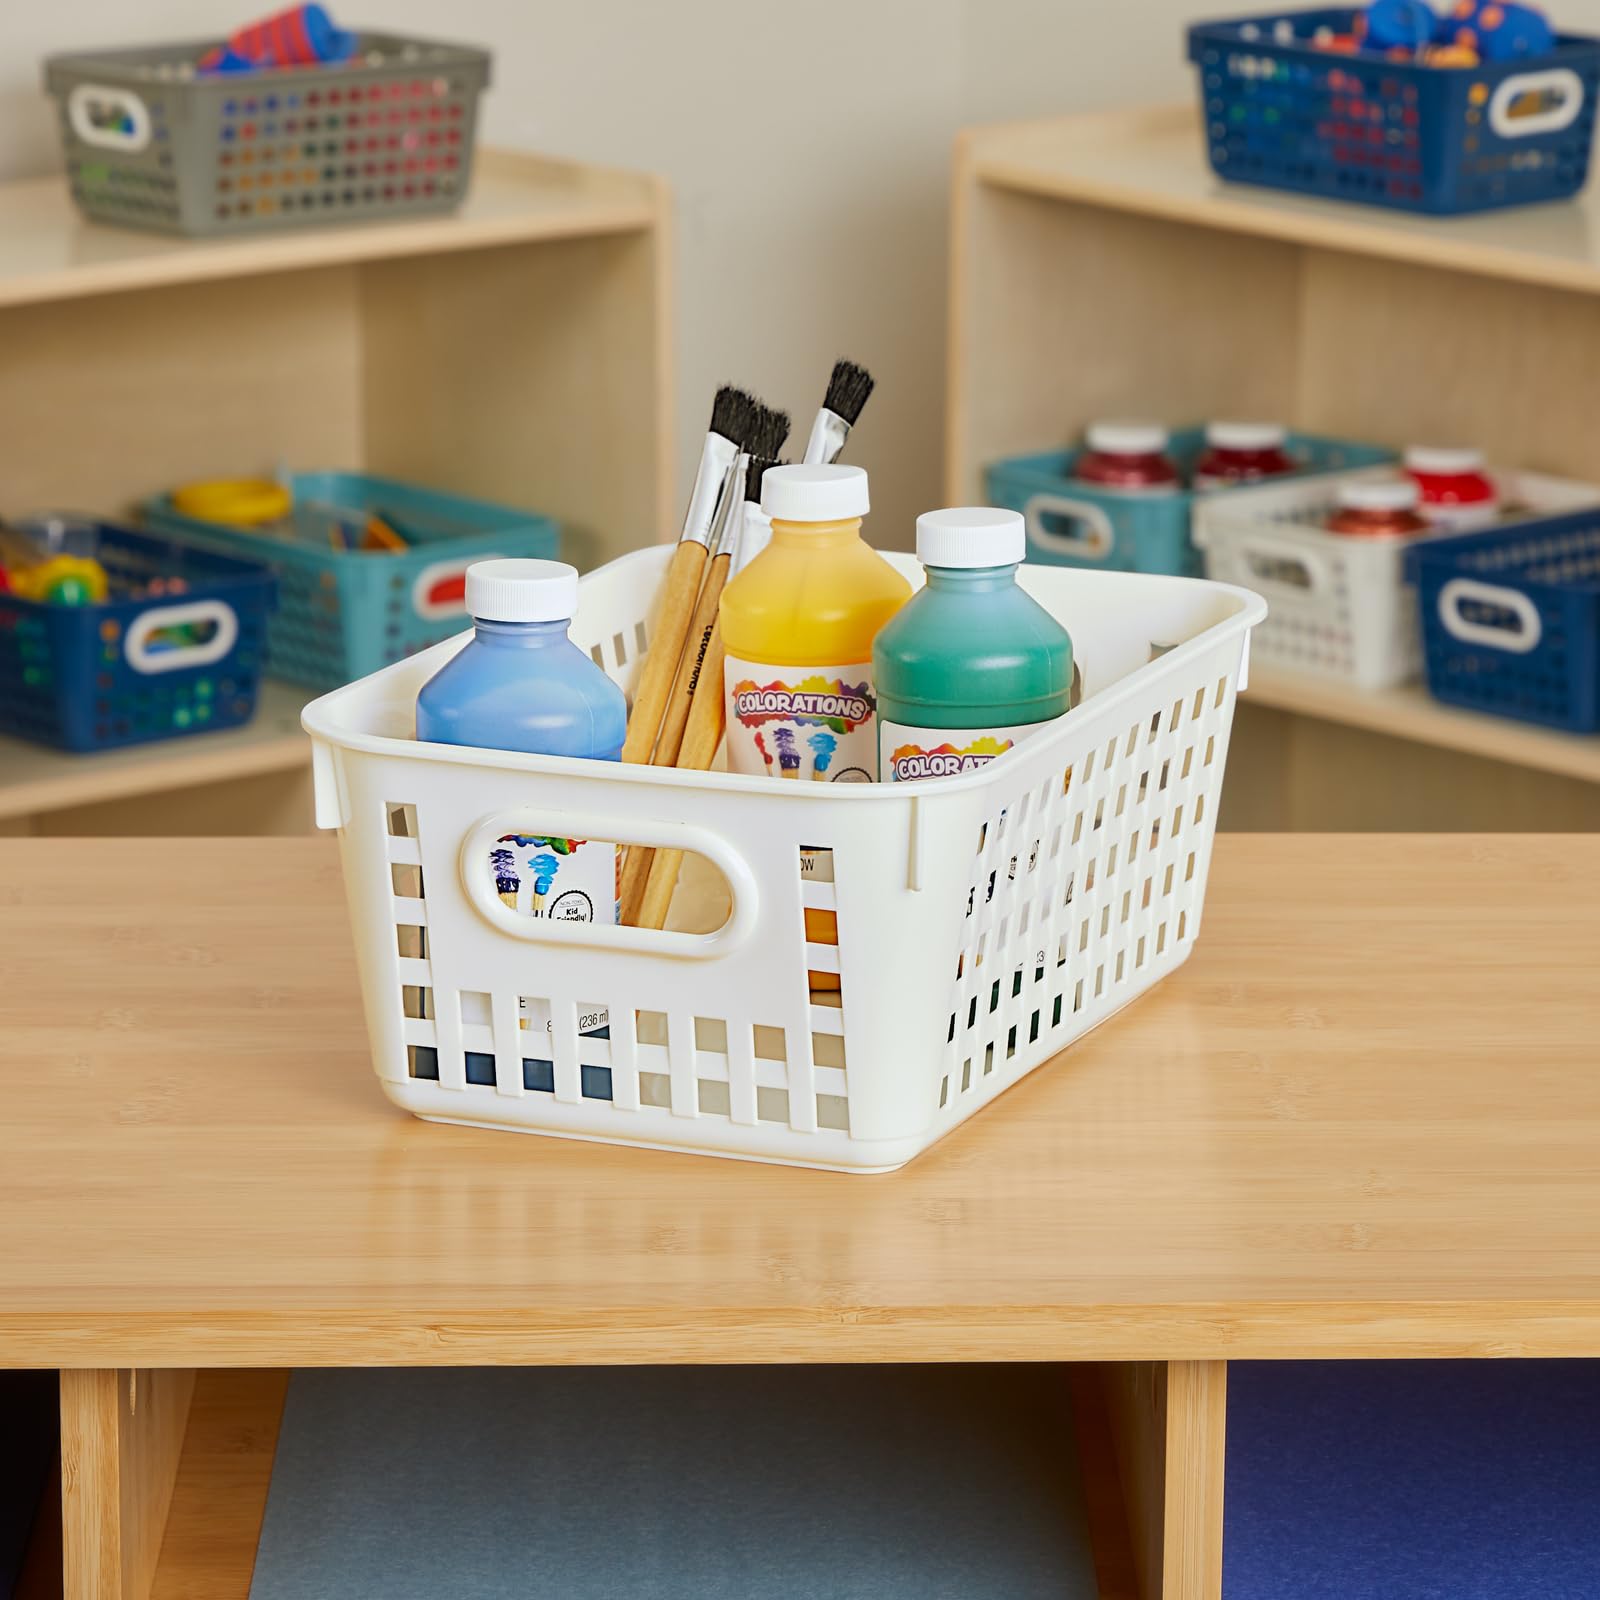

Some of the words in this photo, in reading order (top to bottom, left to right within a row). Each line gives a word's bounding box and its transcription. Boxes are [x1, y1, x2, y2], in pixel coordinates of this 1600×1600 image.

[738, 692, 866, 721] COLORATIONS
[898, 755, 996, 780] COLORAT
[566, 907, 578, 915] Kid
[578, 1013, 598, 1030] (236
